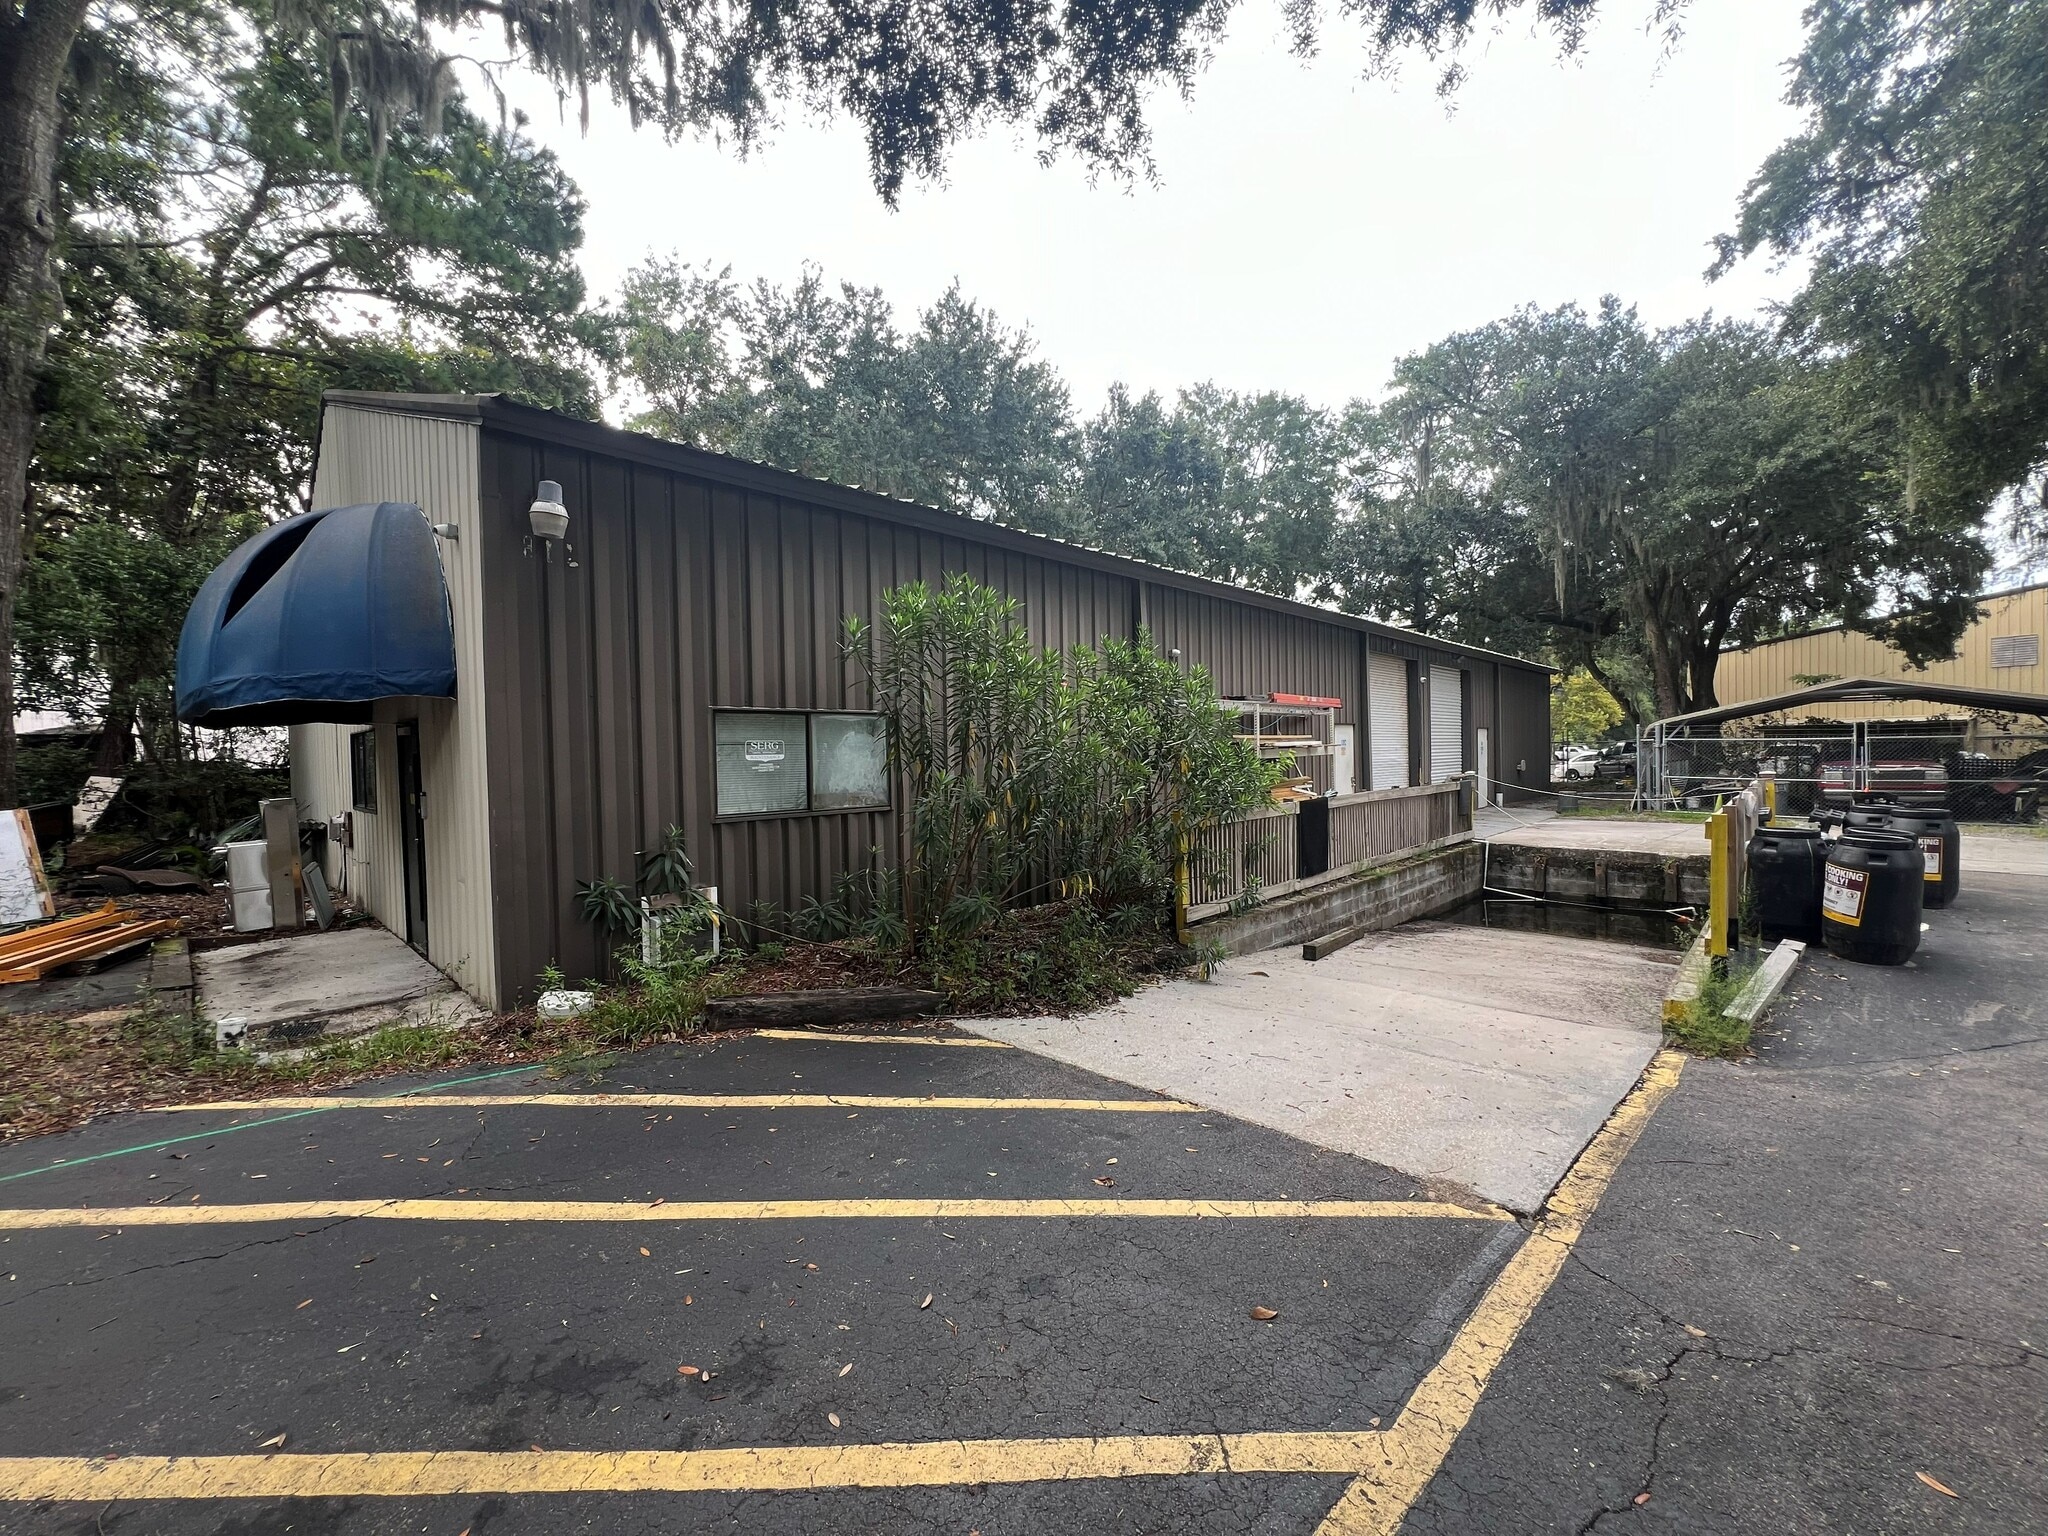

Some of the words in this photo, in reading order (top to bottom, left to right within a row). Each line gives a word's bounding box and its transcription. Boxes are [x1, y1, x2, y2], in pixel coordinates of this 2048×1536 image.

[750, 741, 779, 750] SERG
[1828, 866, 1864, 881] COOKING
[1828, 873, 1848, 886] ONLY!
